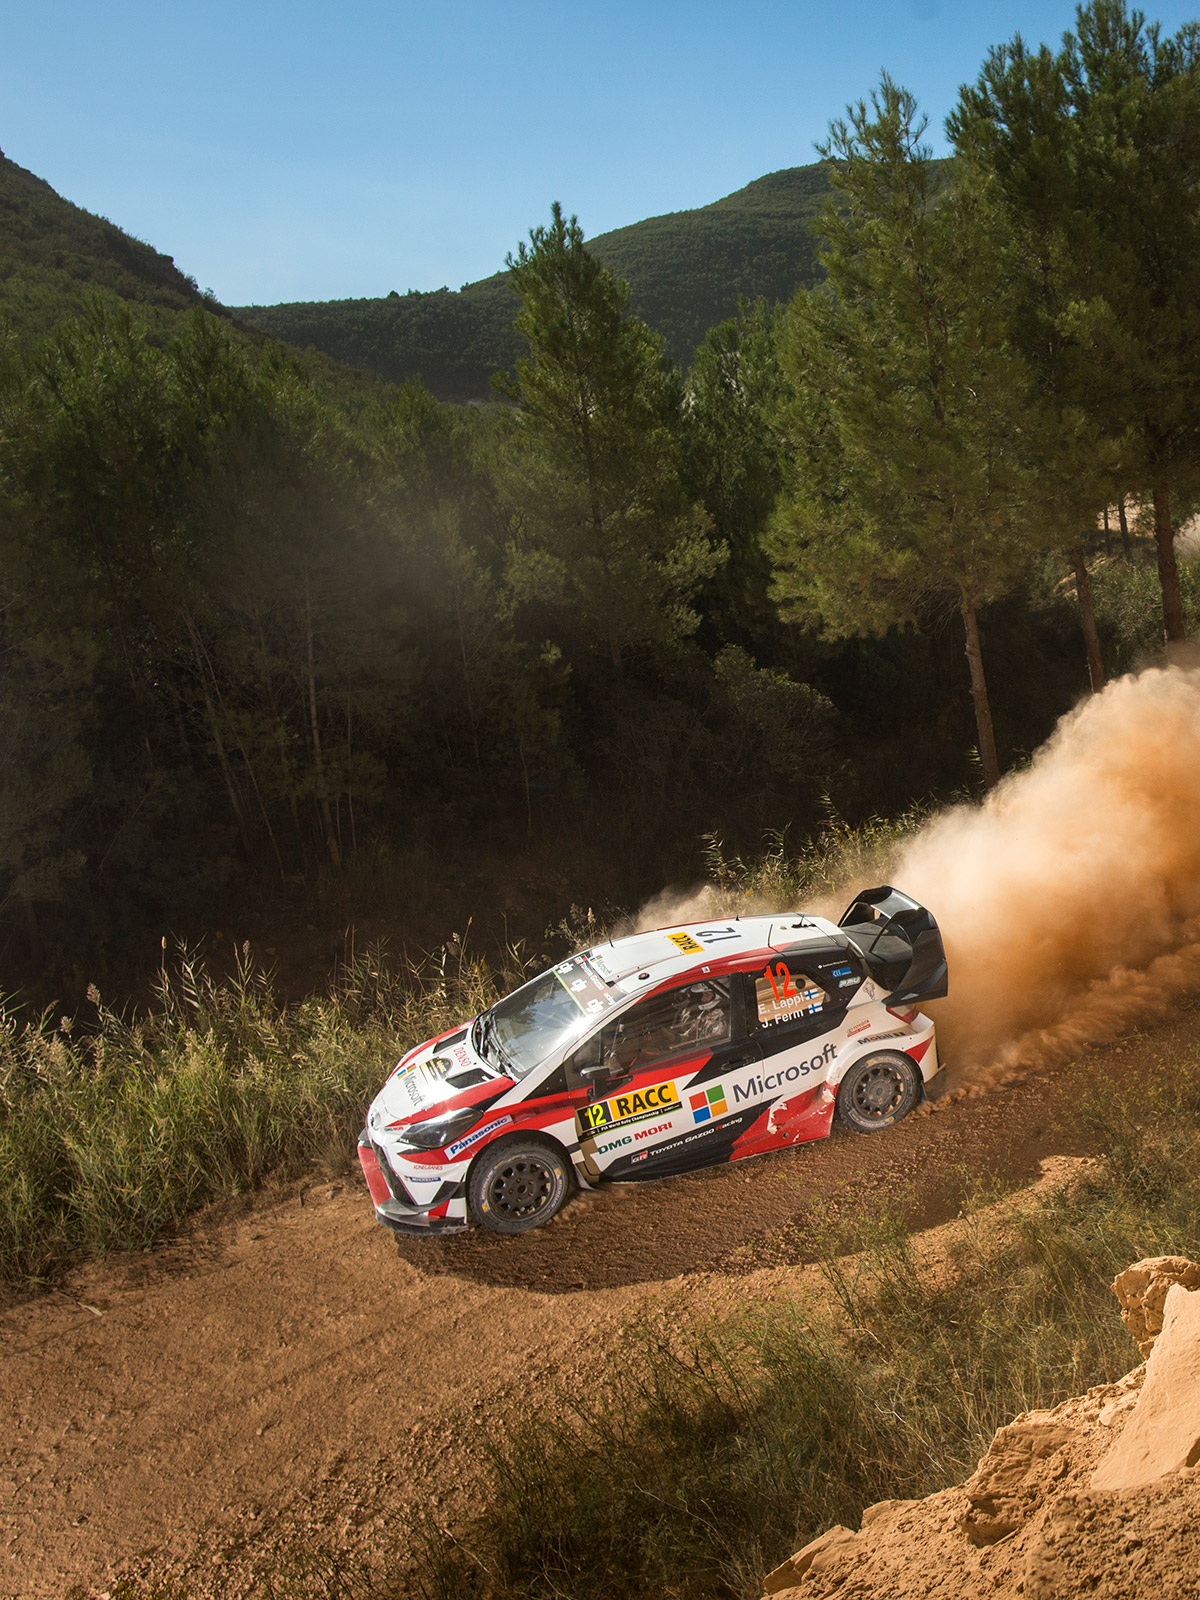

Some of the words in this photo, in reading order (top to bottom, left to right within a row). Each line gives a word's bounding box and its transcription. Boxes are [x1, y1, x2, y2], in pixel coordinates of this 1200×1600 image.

[671, 934, 699, 951] RACC
[696, 927, 742, 945] 12
[763, 961, 796, 1001] 12
[757, 1002, 771, 1015] E.
[772, 991, 805, 1011] Lappi
[761, 1017, 773, 1029] J.
[774, 1009, 804, 1025] Ferm
[857, 1032, 893, 1045] Mobil
[453, 1046, 472, 1068] DENSO
[732, 1043, 839, 1103] Microsoft
[402, 1071, 425, 1107] Microsoft
[616, 1084, 672, 1117] RACC
[584, 1104, 607, 1128] 12
[450, 1116, 508, 1155] Panasonic
[597, 1135, 633, 1155] DMG
[633, 1121, 673, 1141] MORI
[649, 1140, 684, 1157] TOYOTA
[684, 1128, 716, 1144] GAZOO
[715, 1117, 744, 1132] Racing
